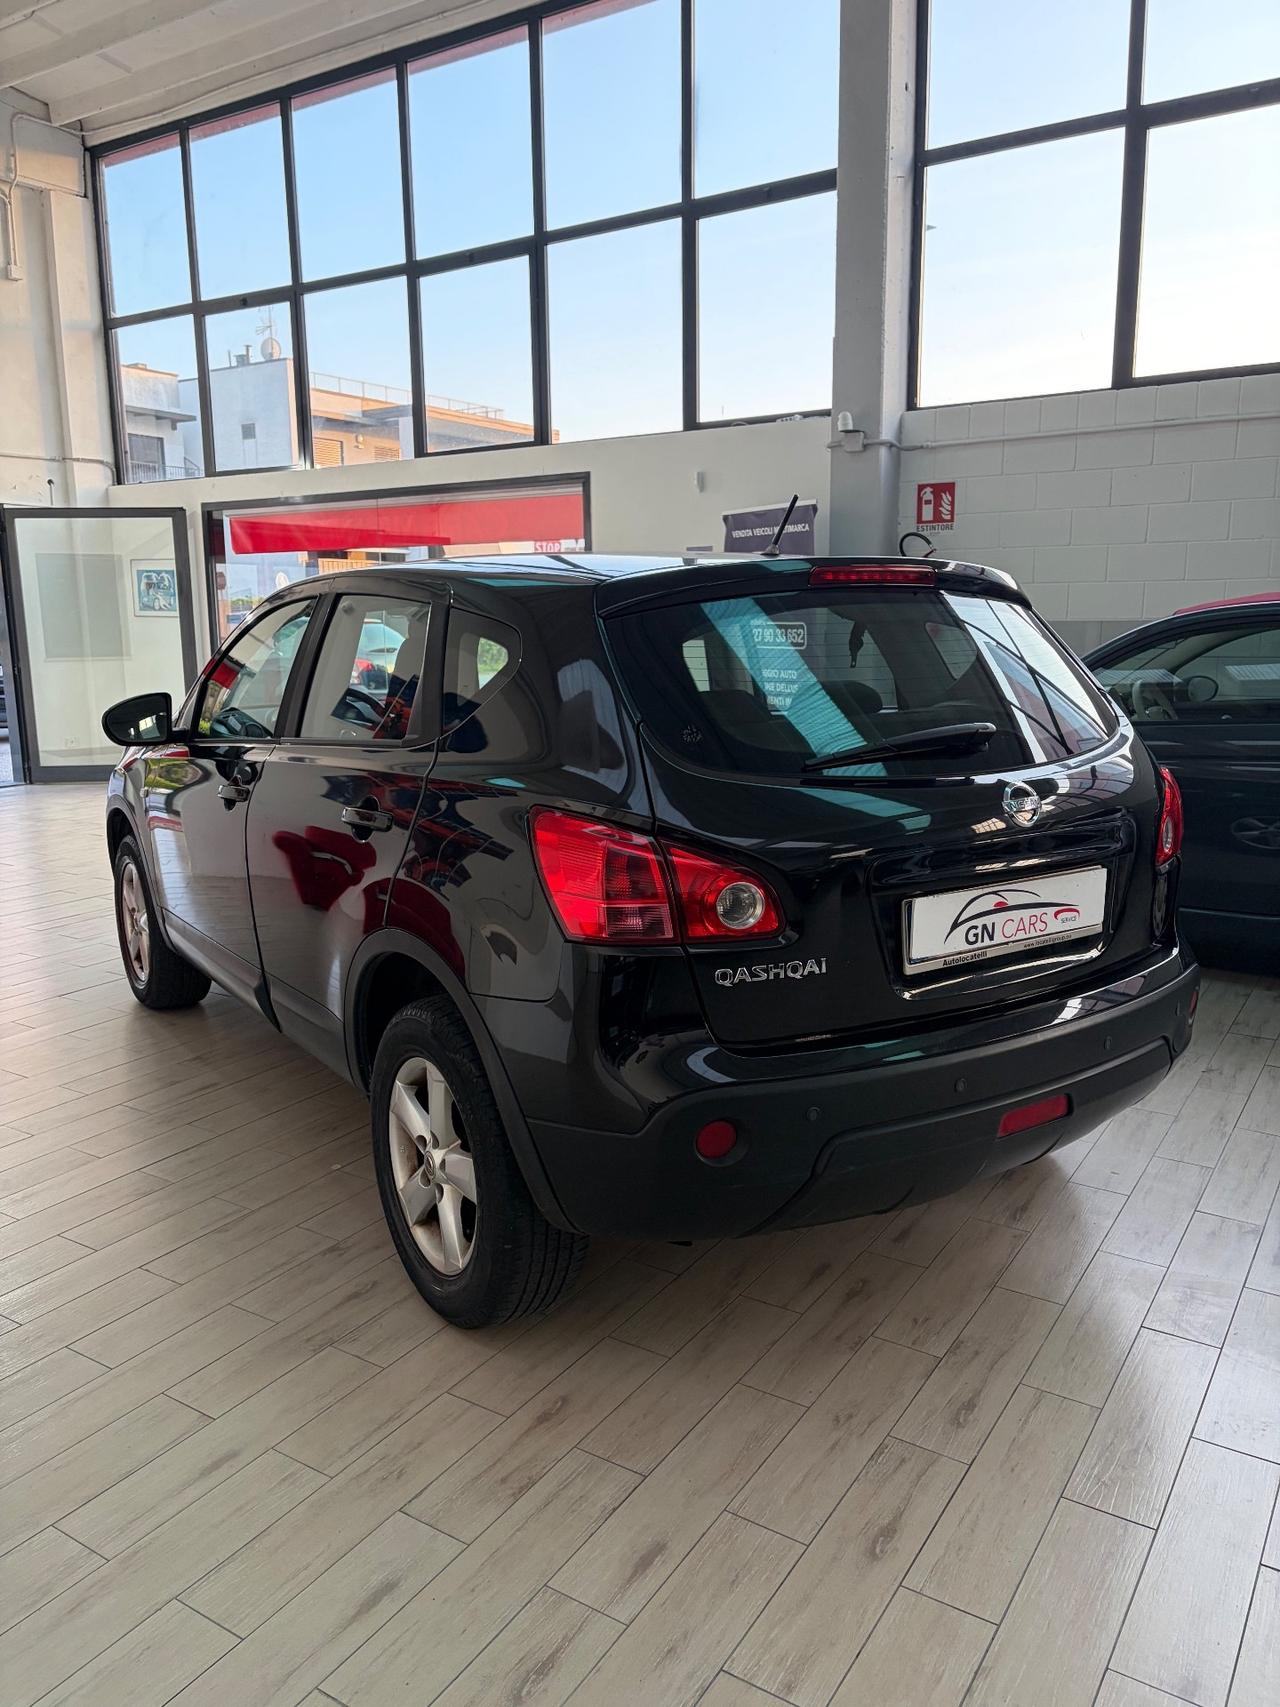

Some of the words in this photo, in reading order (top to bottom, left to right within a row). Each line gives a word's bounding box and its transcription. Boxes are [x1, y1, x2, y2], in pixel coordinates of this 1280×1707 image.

[774, 523, 809, 534] MTIMARCA
[916, 523, 954, 532] ESTINTORE
[535, 541, 561, 552] STOP
[965, 921, 995, 946] GN
[1001, 912, 1048, 939] CARS
[942, 950, 988, 967] Autolocatelli
[714, 957, 827, 987] QASHQAI
